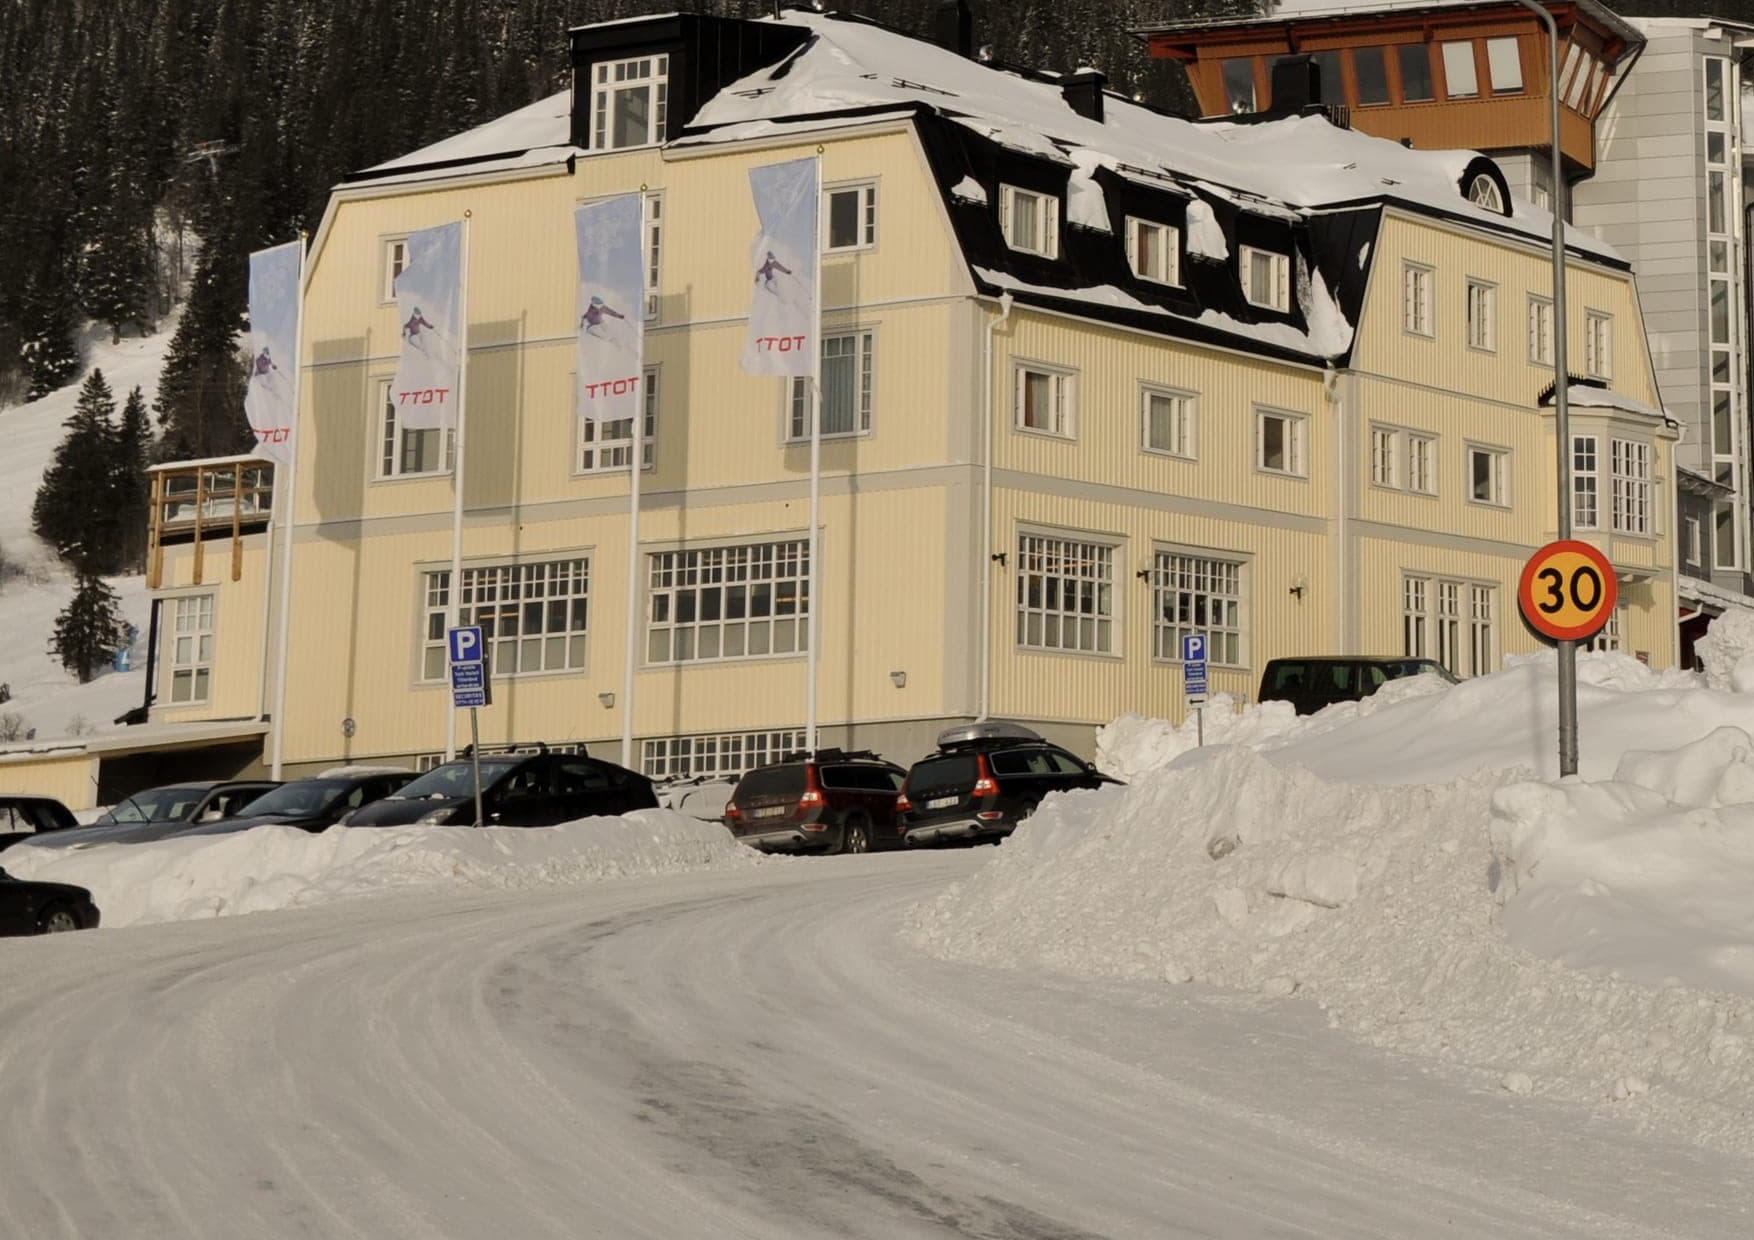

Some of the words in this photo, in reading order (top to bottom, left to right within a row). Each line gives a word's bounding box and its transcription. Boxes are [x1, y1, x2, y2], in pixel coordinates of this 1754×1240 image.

[1537, 565, 1602, 615] 30
[456, 630, 476, 660] P
[1188, 637, 1202, 659] P
